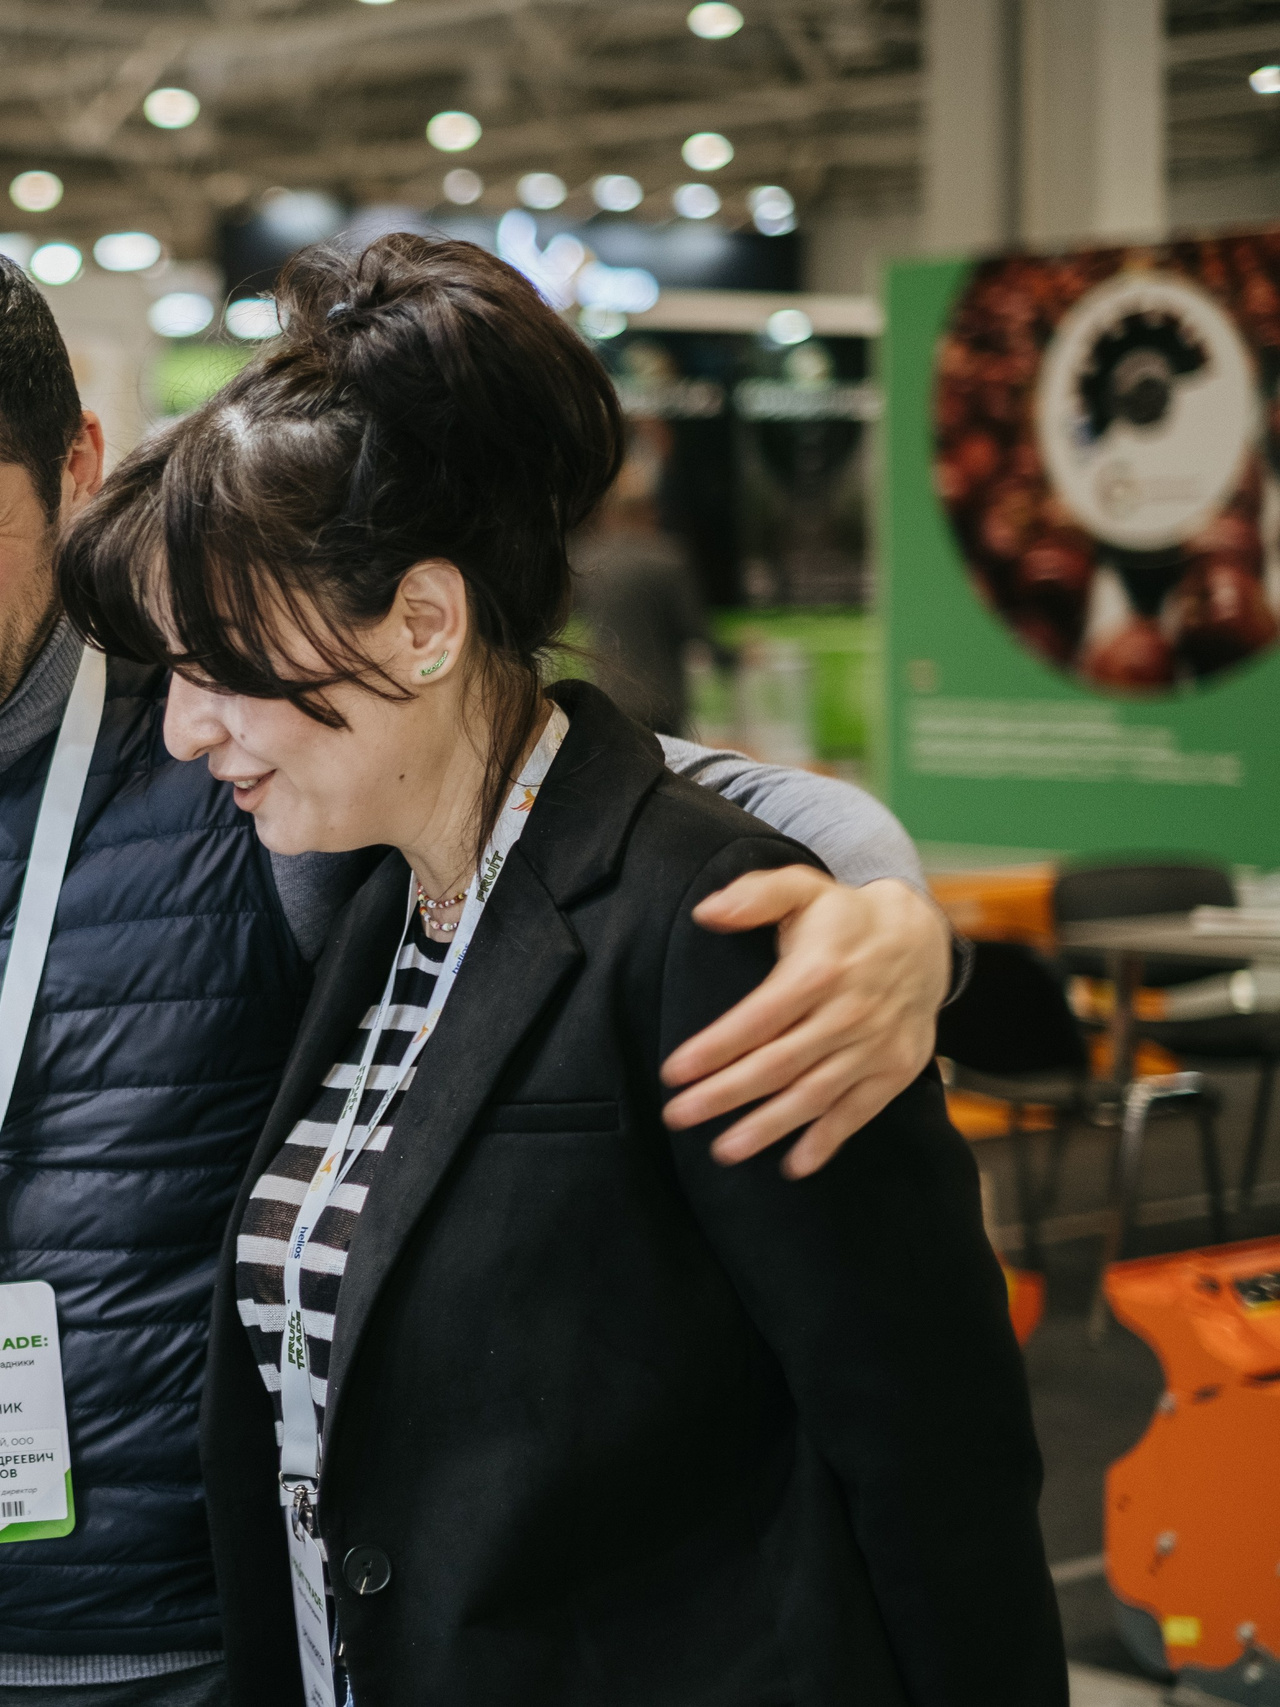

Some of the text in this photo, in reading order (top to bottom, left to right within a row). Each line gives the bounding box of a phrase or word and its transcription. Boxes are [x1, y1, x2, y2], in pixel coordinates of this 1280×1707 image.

[293, 1226, 309, 1260] helios
[10, 1436, 35, 1447] ООО
[1, 1487, 38, 1497] директор
